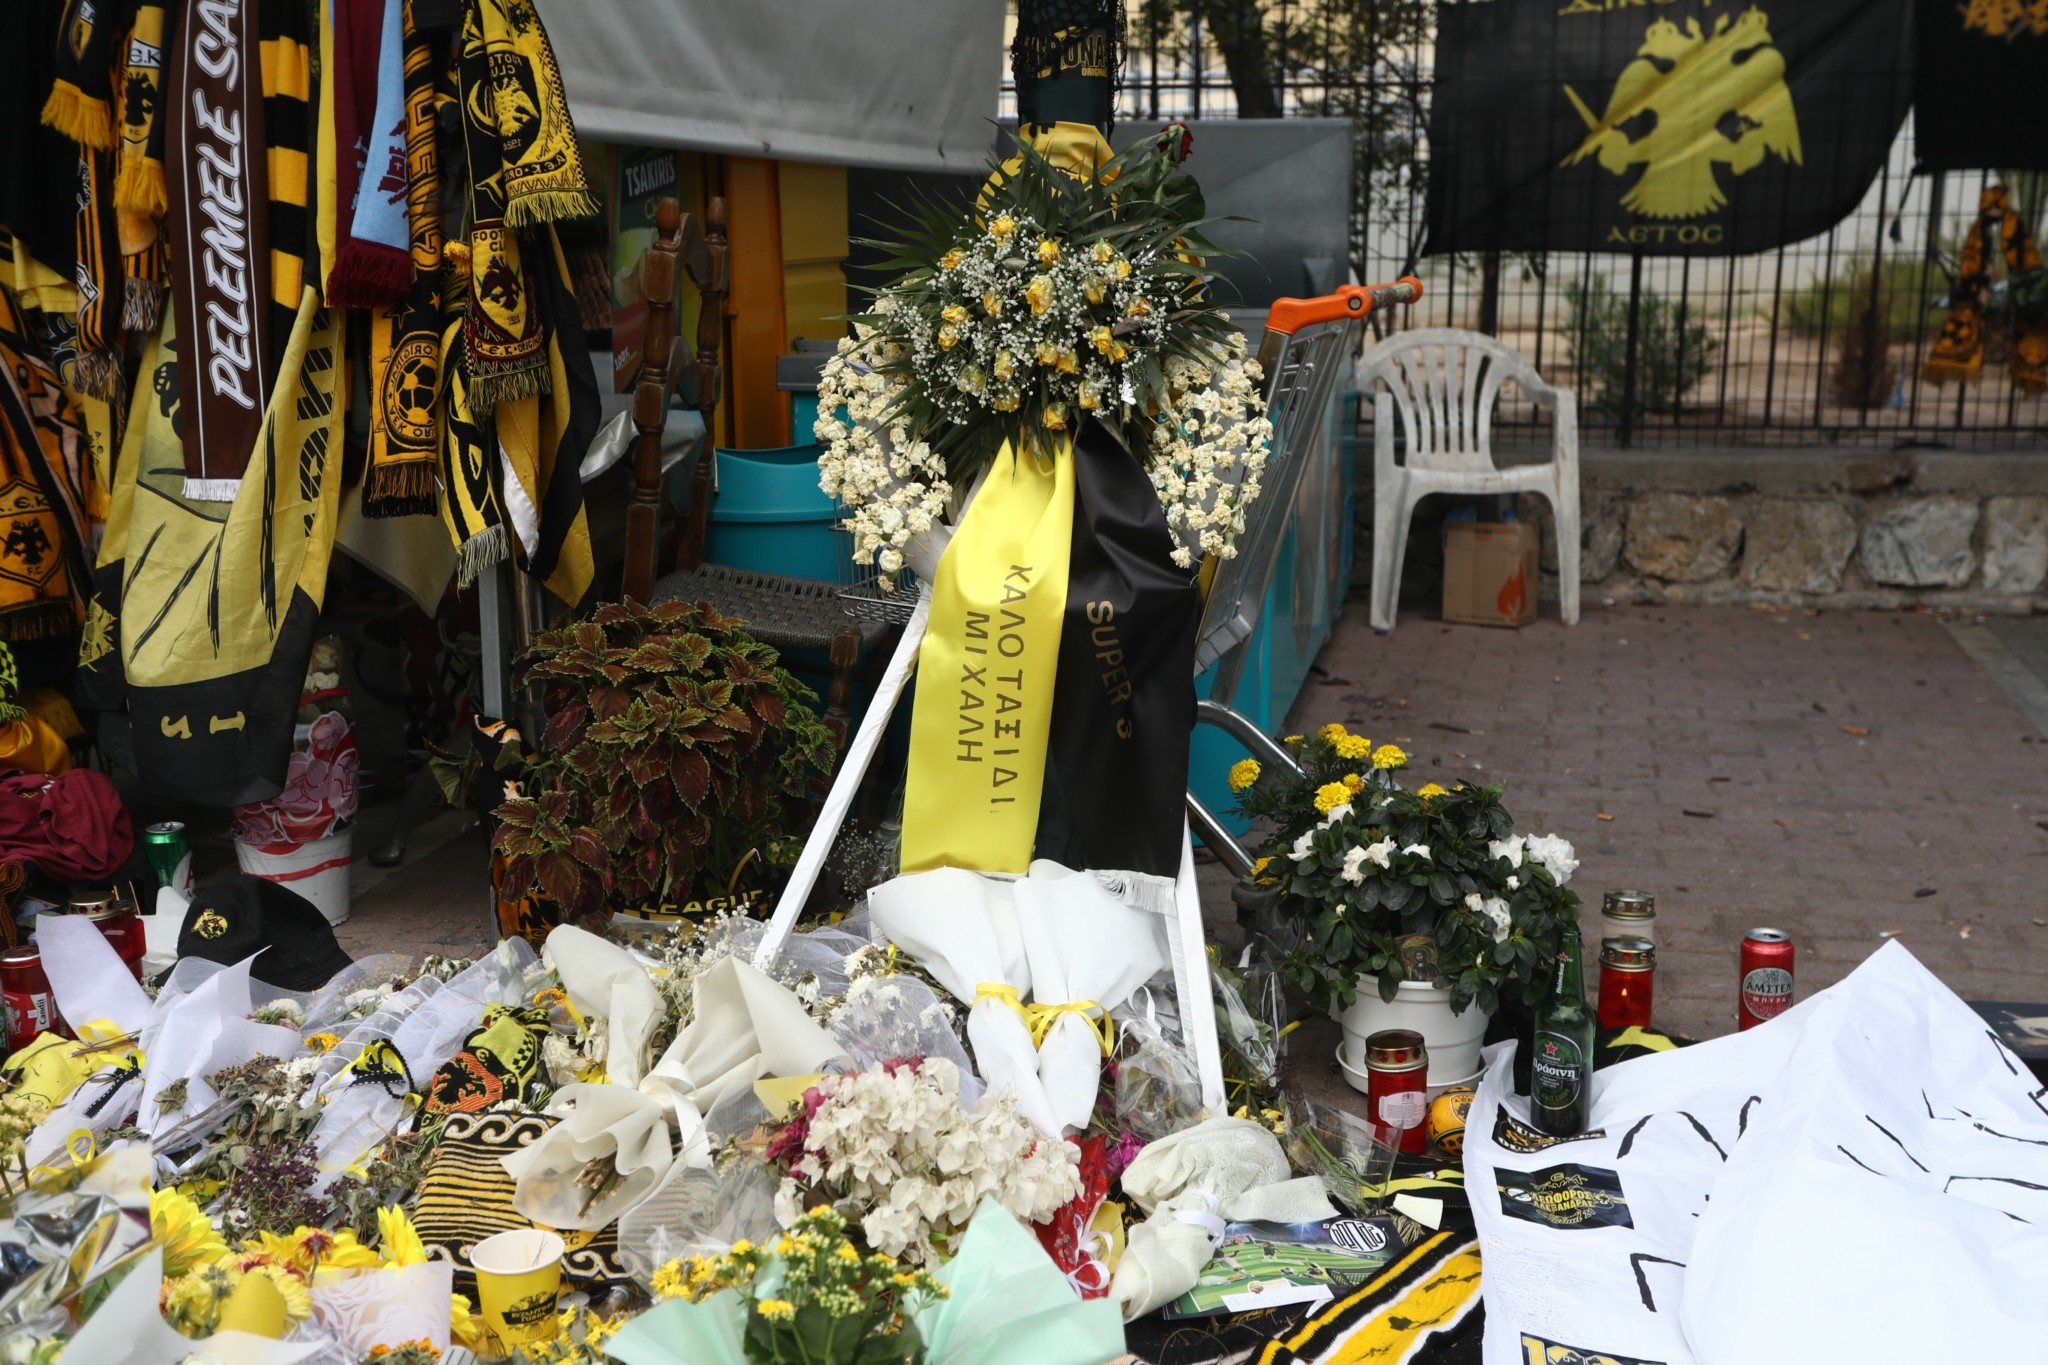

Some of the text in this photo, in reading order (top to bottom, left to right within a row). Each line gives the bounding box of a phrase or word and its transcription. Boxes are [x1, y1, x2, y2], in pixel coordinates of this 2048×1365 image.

[625, 154, 676, 198] TSAKIRIS
[192, 87, 256, 411] PELEMELE
[1086, 600, 1132, 706] SUPER
[956, 611, 990, 763] ΜΙΧΑΛΗ
[990, 564, 1033, 804] ΚΑΛΟ ΤΑΞΙΔΙ
[641, 889, 763, 914] LEAGUE
[1555, 962, 1565, 995] Heineken
[1746, 982, 1791, 994] ΑΜΣΤΕΛ
[37, 998, 47, 1025] Candil
[1533, 1057, 1576, 1079] Πράσινη
[1531, 1189, 1593, 1205] ΛΕΩΦΟΡΟΣ
